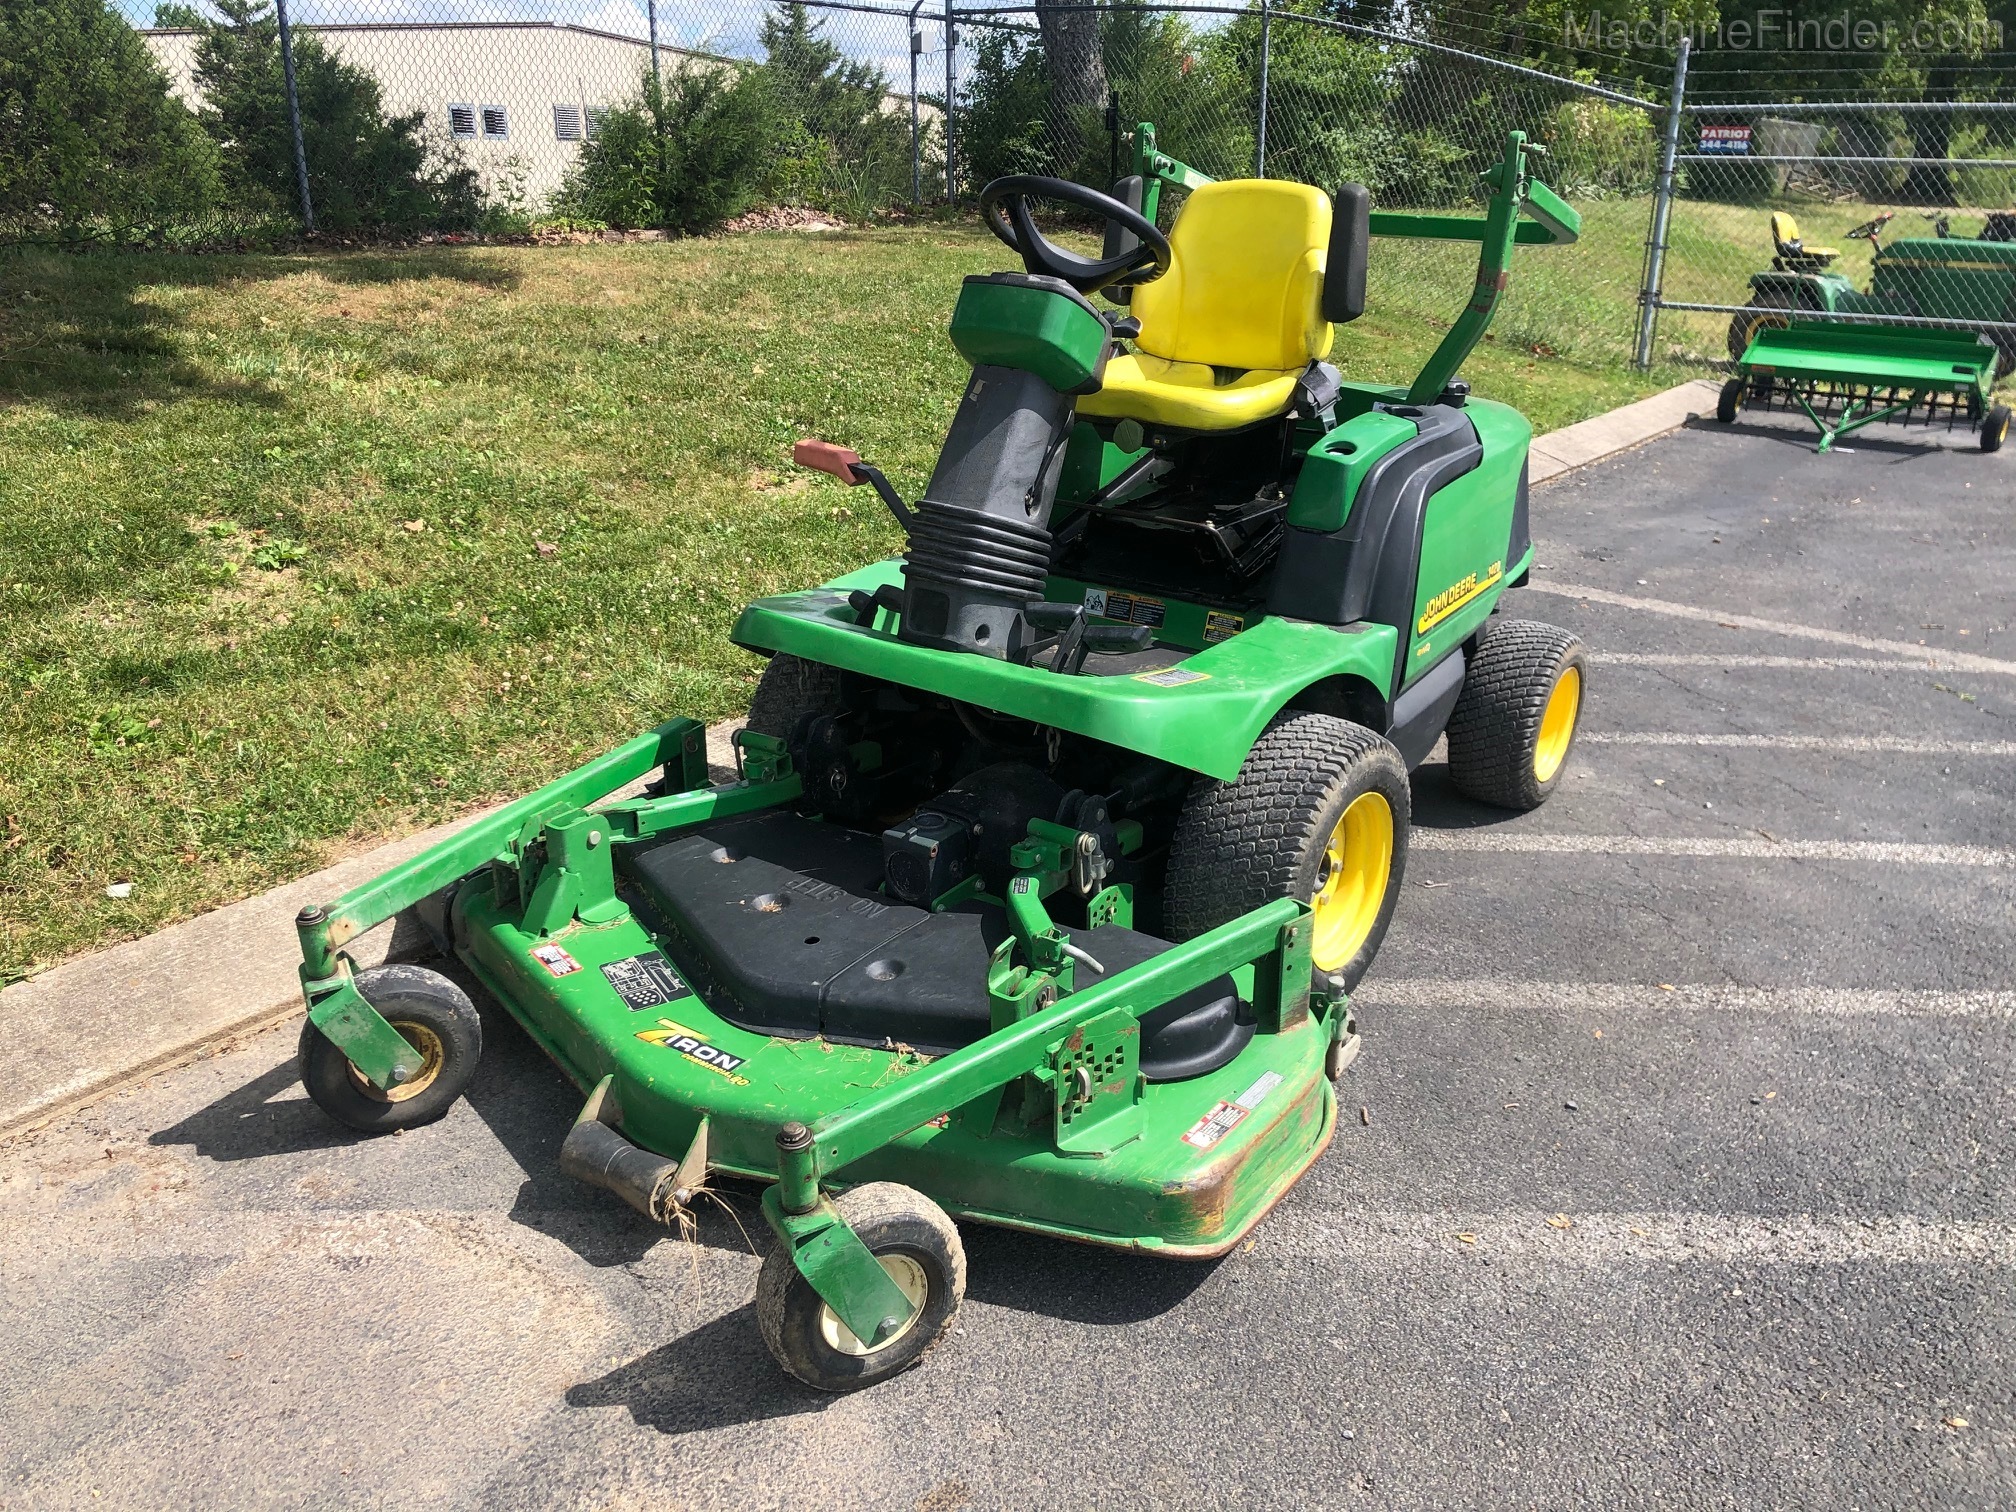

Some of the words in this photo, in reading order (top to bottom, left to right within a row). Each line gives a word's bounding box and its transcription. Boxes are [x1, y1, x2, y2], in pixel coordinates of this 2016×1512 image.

[1701, 128, 1751, 139] PATRIOT
[1423, 590, 1449, 621] JOHN
[1448, 572, 1477, 604] DEERE
